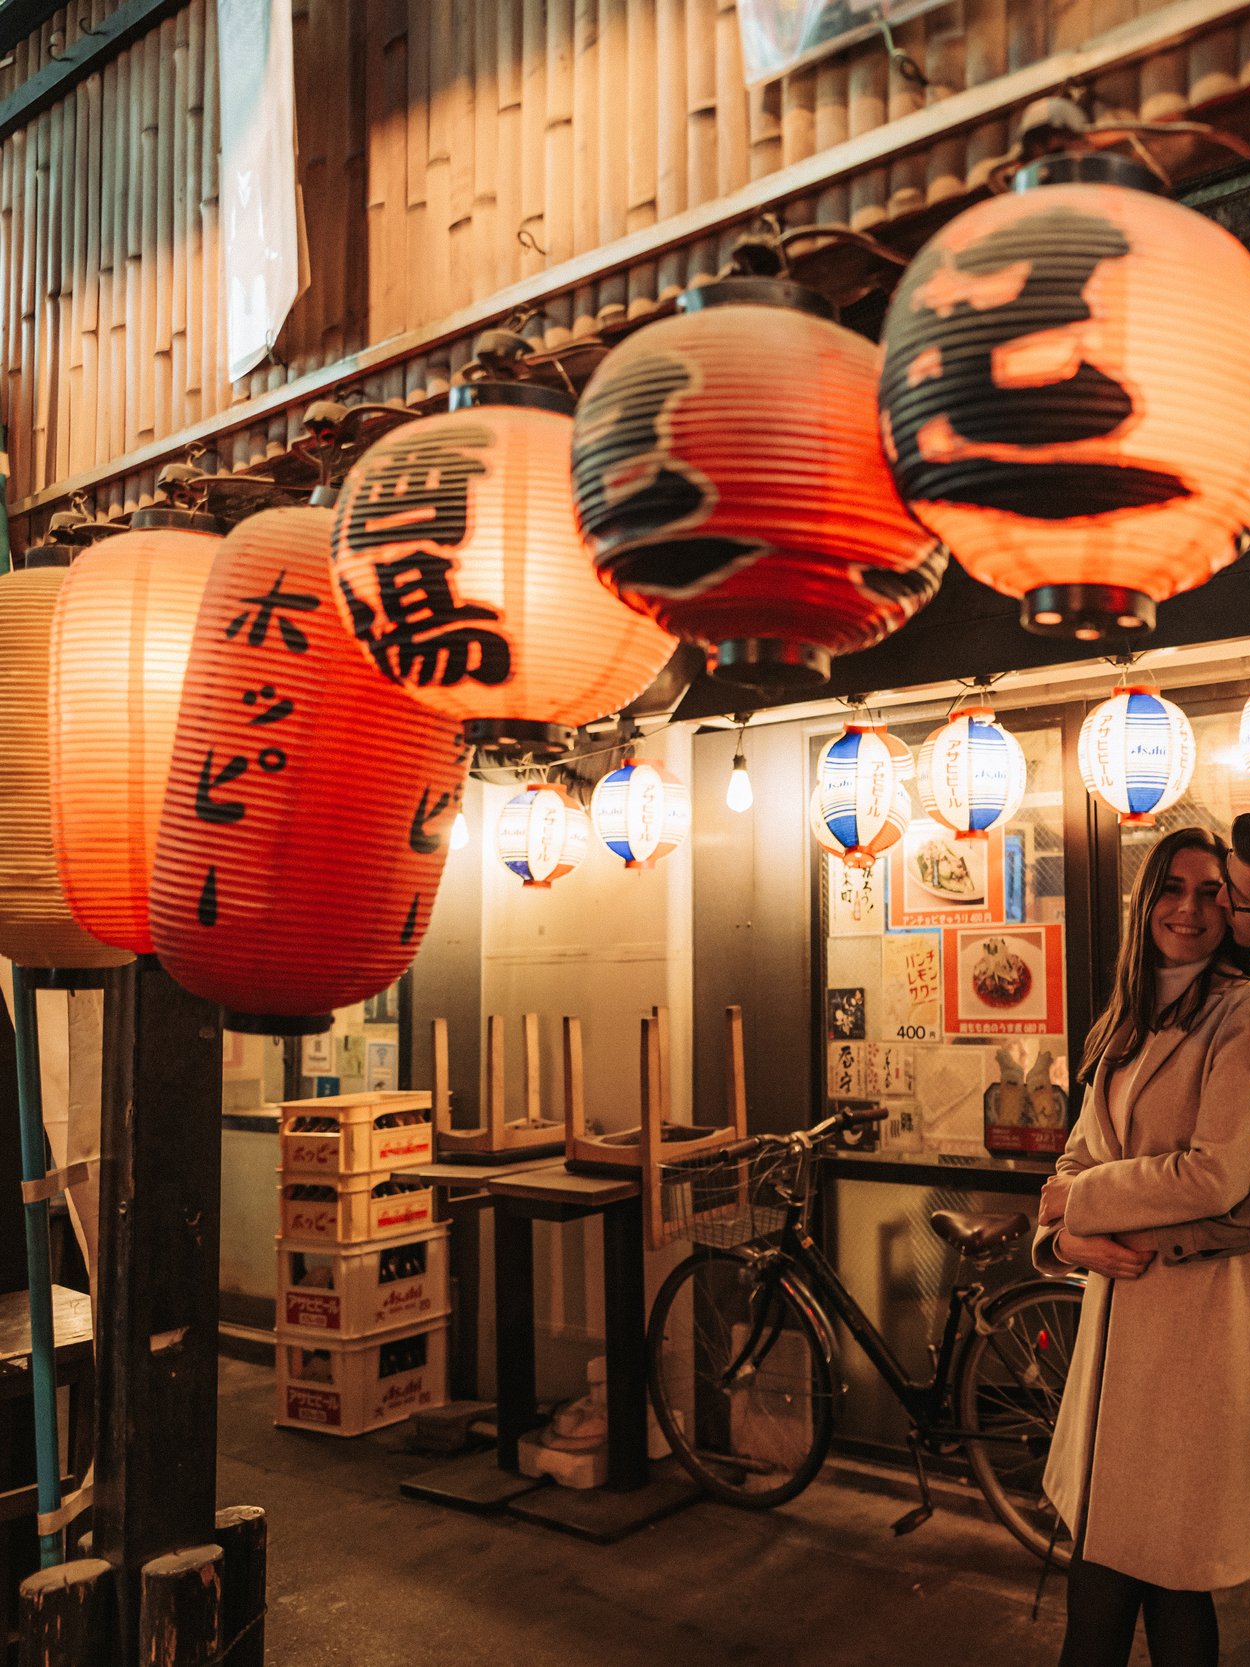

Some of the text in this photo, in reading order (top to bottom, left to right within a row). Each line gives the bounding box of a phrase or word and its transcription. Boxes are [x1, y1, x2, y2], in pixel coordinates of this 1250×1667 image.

[195, 569, 320, 928] ホッピー
[946, 739, 963, 809] アサヒビール
[1099, 714, 1115, 787] アサヒビール
[1130, 744, 1167, 756] Asahi
[897, 1026, 926, 1039] 400
